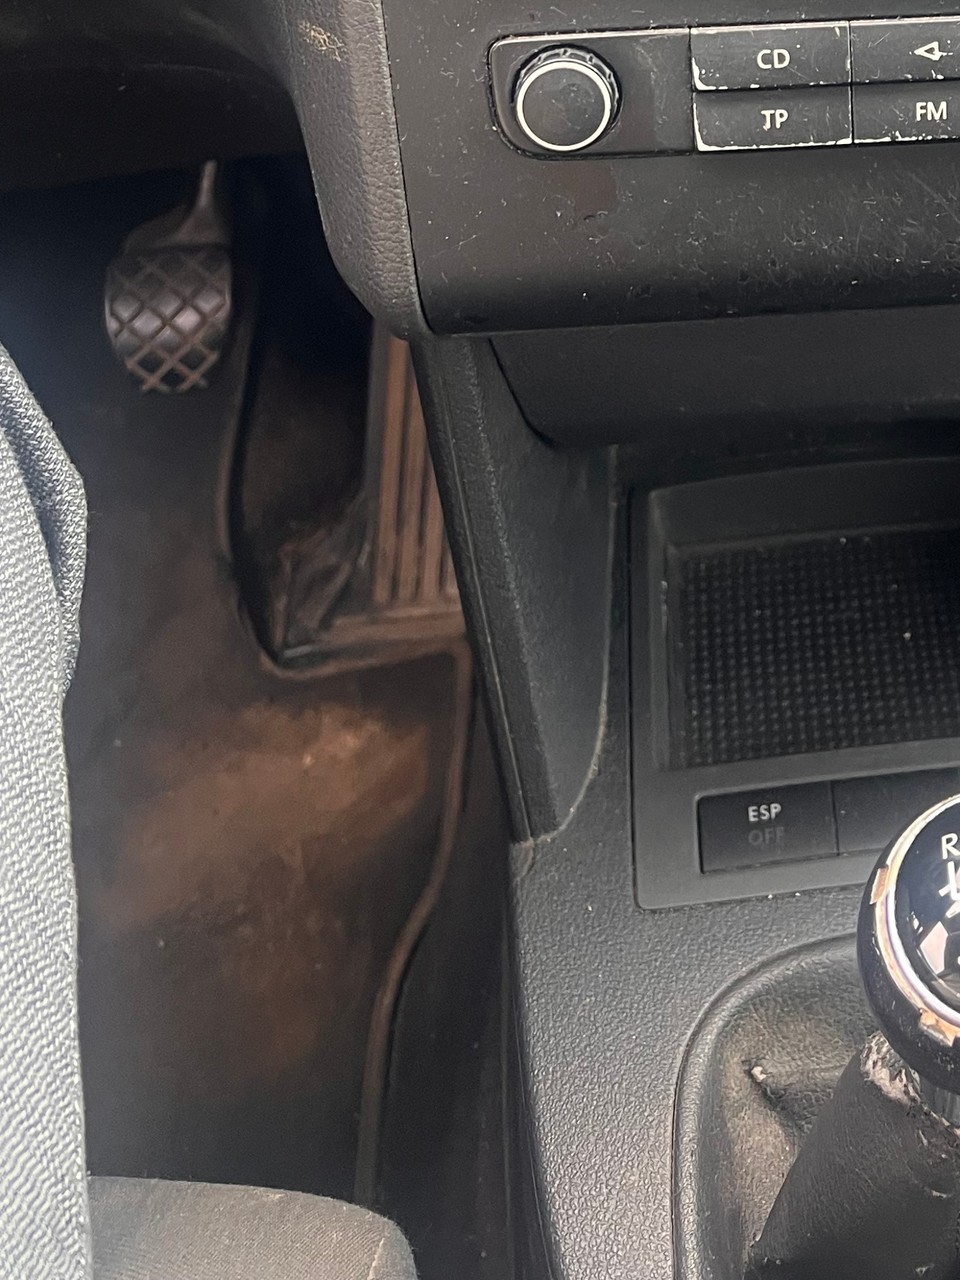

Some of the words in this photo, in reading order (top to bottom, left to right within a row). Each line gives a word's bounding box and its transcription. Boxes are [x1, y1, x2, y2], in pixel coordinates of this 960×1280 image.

[757, 48, 790, 70] CD
[761, 108, 789, 130] TP
[914, 101, 948, 122] FM
[747, 802, 782, 823] ESP
[941, 833, 960, 857] R
